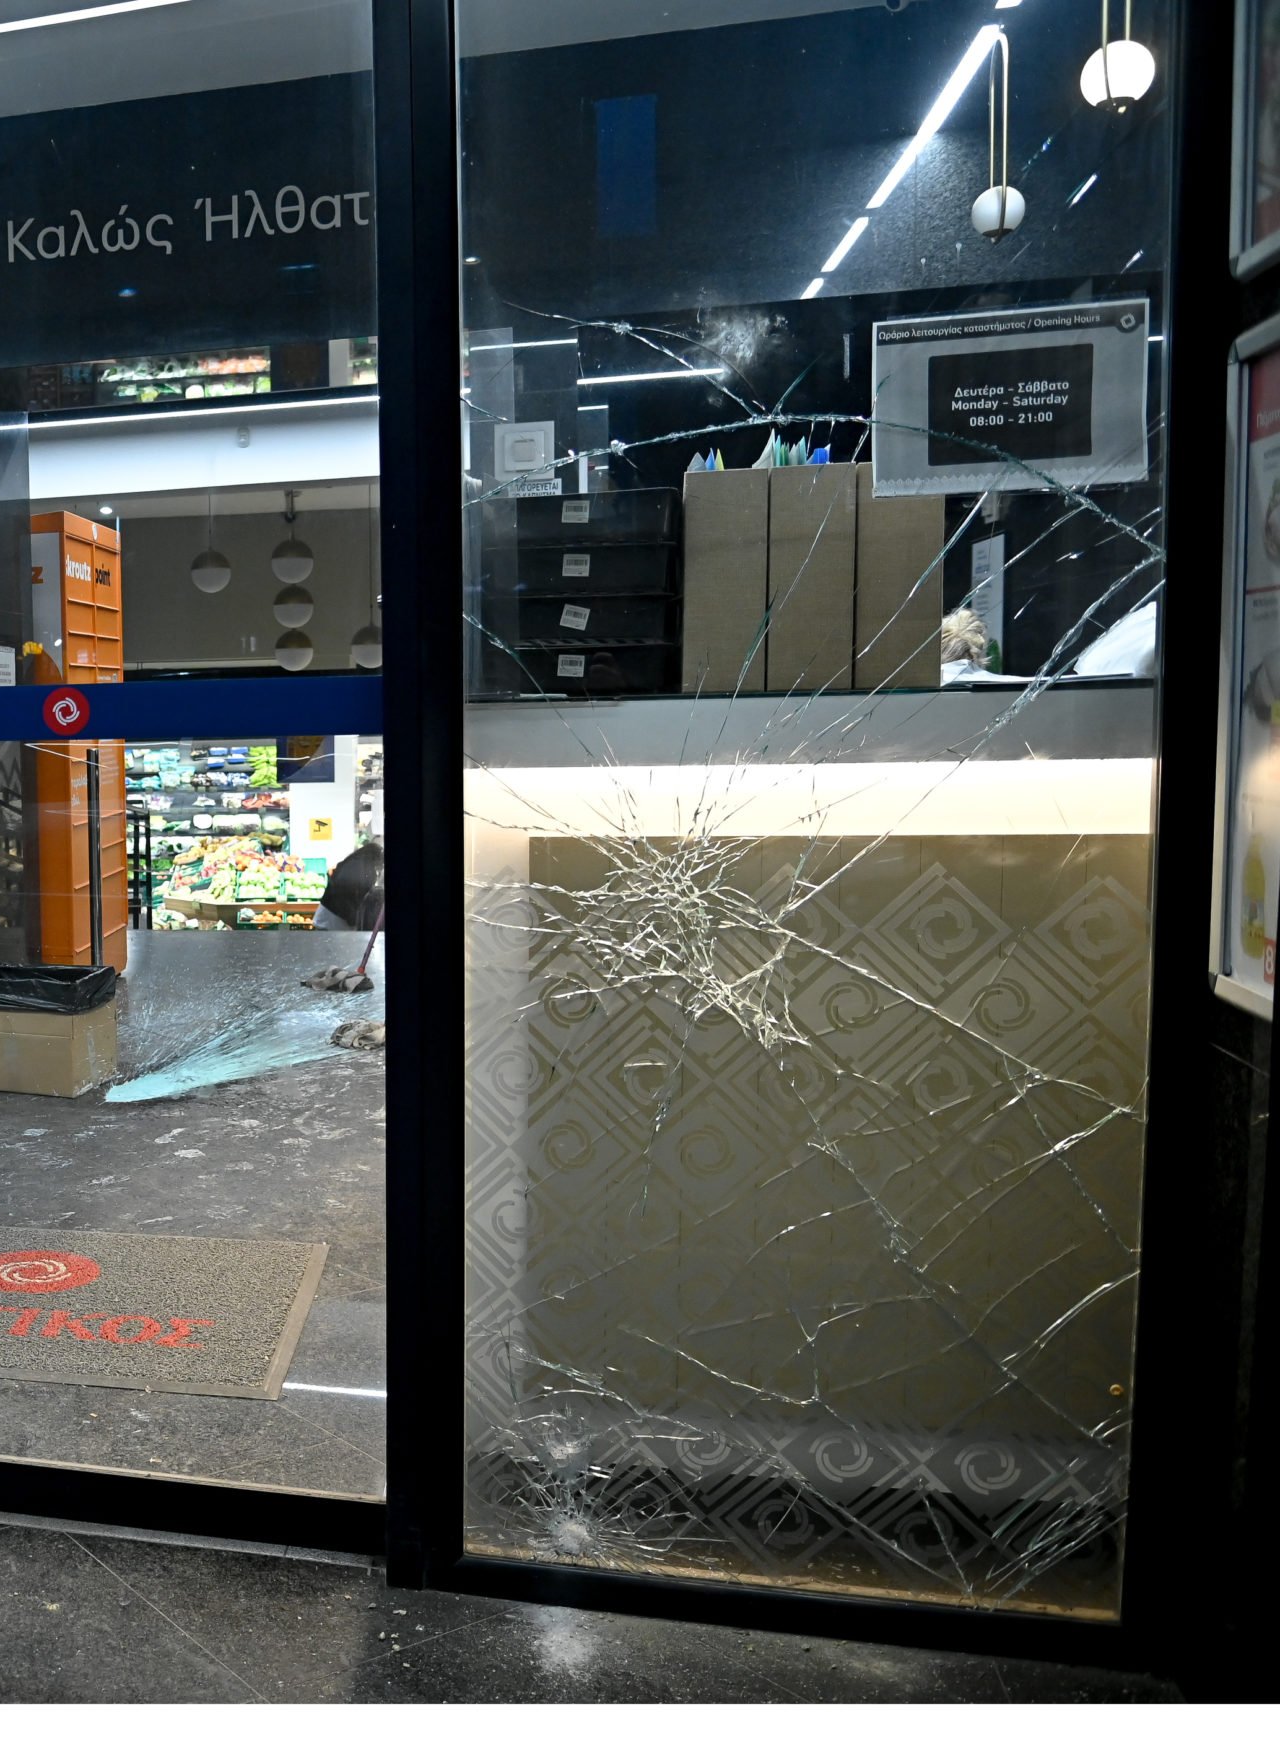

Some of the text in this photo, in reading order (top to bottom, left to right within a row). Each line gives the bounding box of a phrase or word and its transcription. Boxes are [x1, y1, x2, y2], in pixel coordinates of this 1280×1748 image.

[8, 204, 174, 263] Καλώς
[879, 331, 910, 341] Ωράριο
[911, 325, 962, 337] λειτουργίας
[964, 320, 1026, 333] καταστήματος
[1034, 316, 1072, 328] Opening
[1073, 314, 1100, 324] Hours
[954, 384, 1004, 398] Δευτέρα
[1017, 380, 1070, 394] Σάββατο
[951, 398, 999, 411] Monday
[1012, 393, 1069, 407] Saturday
[969, 414, 1004, 427] 08:00
[1017, 411, 1053, 424] 21:00
